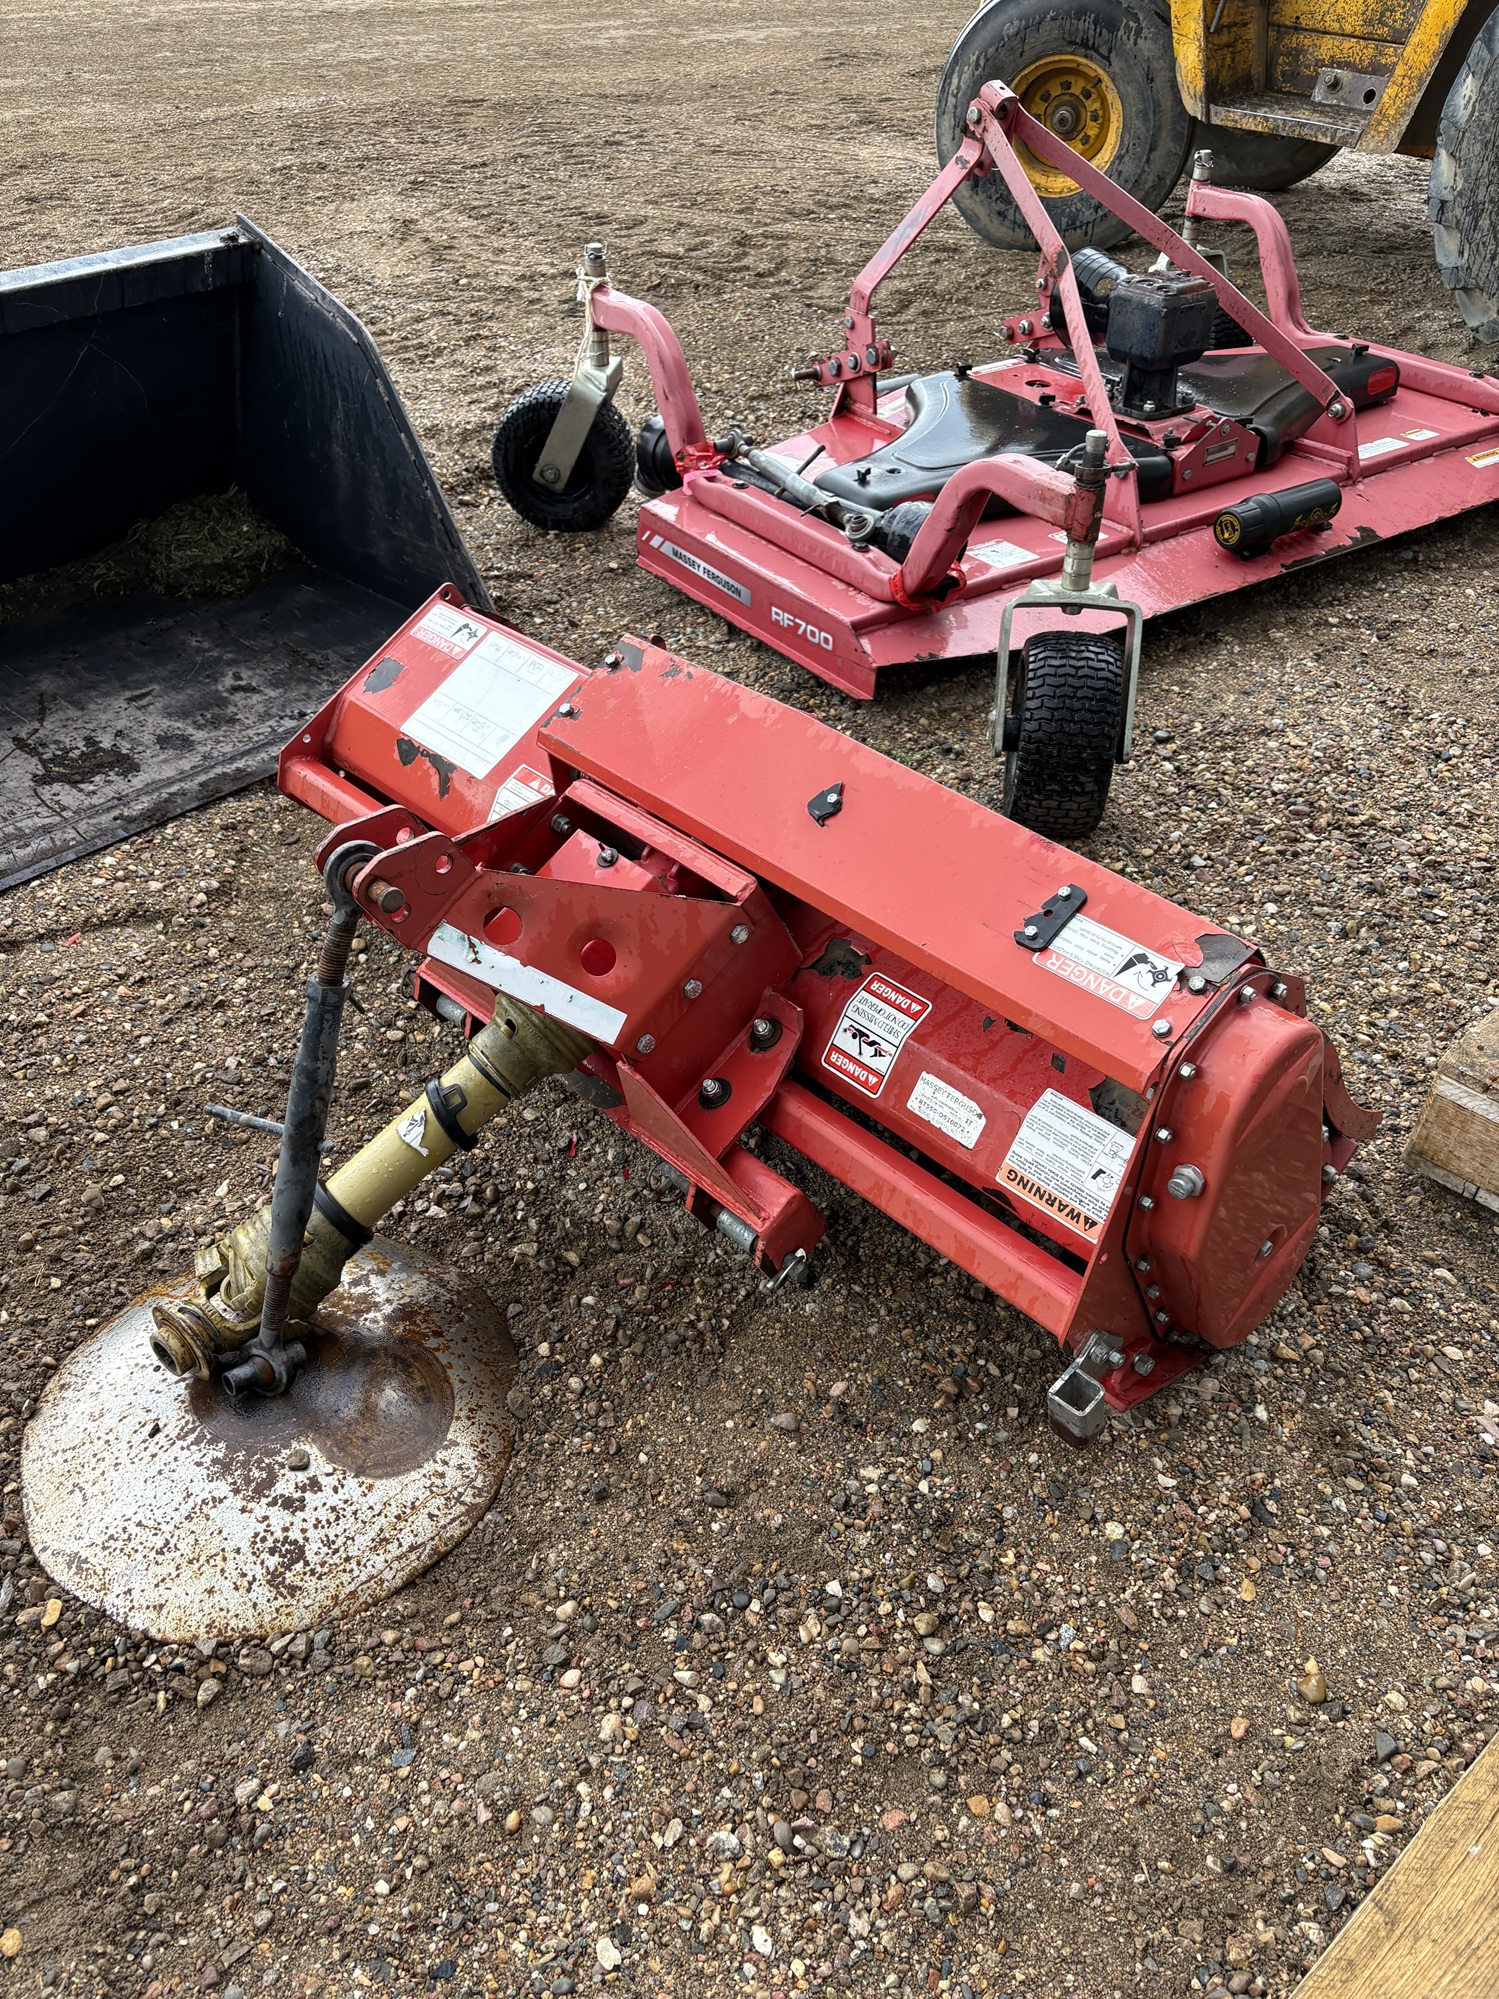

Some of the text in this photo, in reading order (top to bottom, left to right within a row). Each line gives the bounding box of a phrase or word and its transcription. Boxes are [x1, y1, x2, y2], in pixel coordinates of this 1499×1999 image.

[671, 547, 742, 599] MASSEY FERGUSON
[417, 628, 453, 651] DANGER
[770, 606, 834, 651] RF700
[869, 979, 911, 1008] DANGER
[1045, 953, 1127, 1002] DANGER
[850, 1003, 901, 1038] SHIELD MISSING
[856, 994, 909, 1030] DO NOT OPERATE
[828, 1050, 868, 1081] DANGER
[919, 1075, 947, 1095] MASSEY
[1004, 1167, 1082, 1224] WARNING
